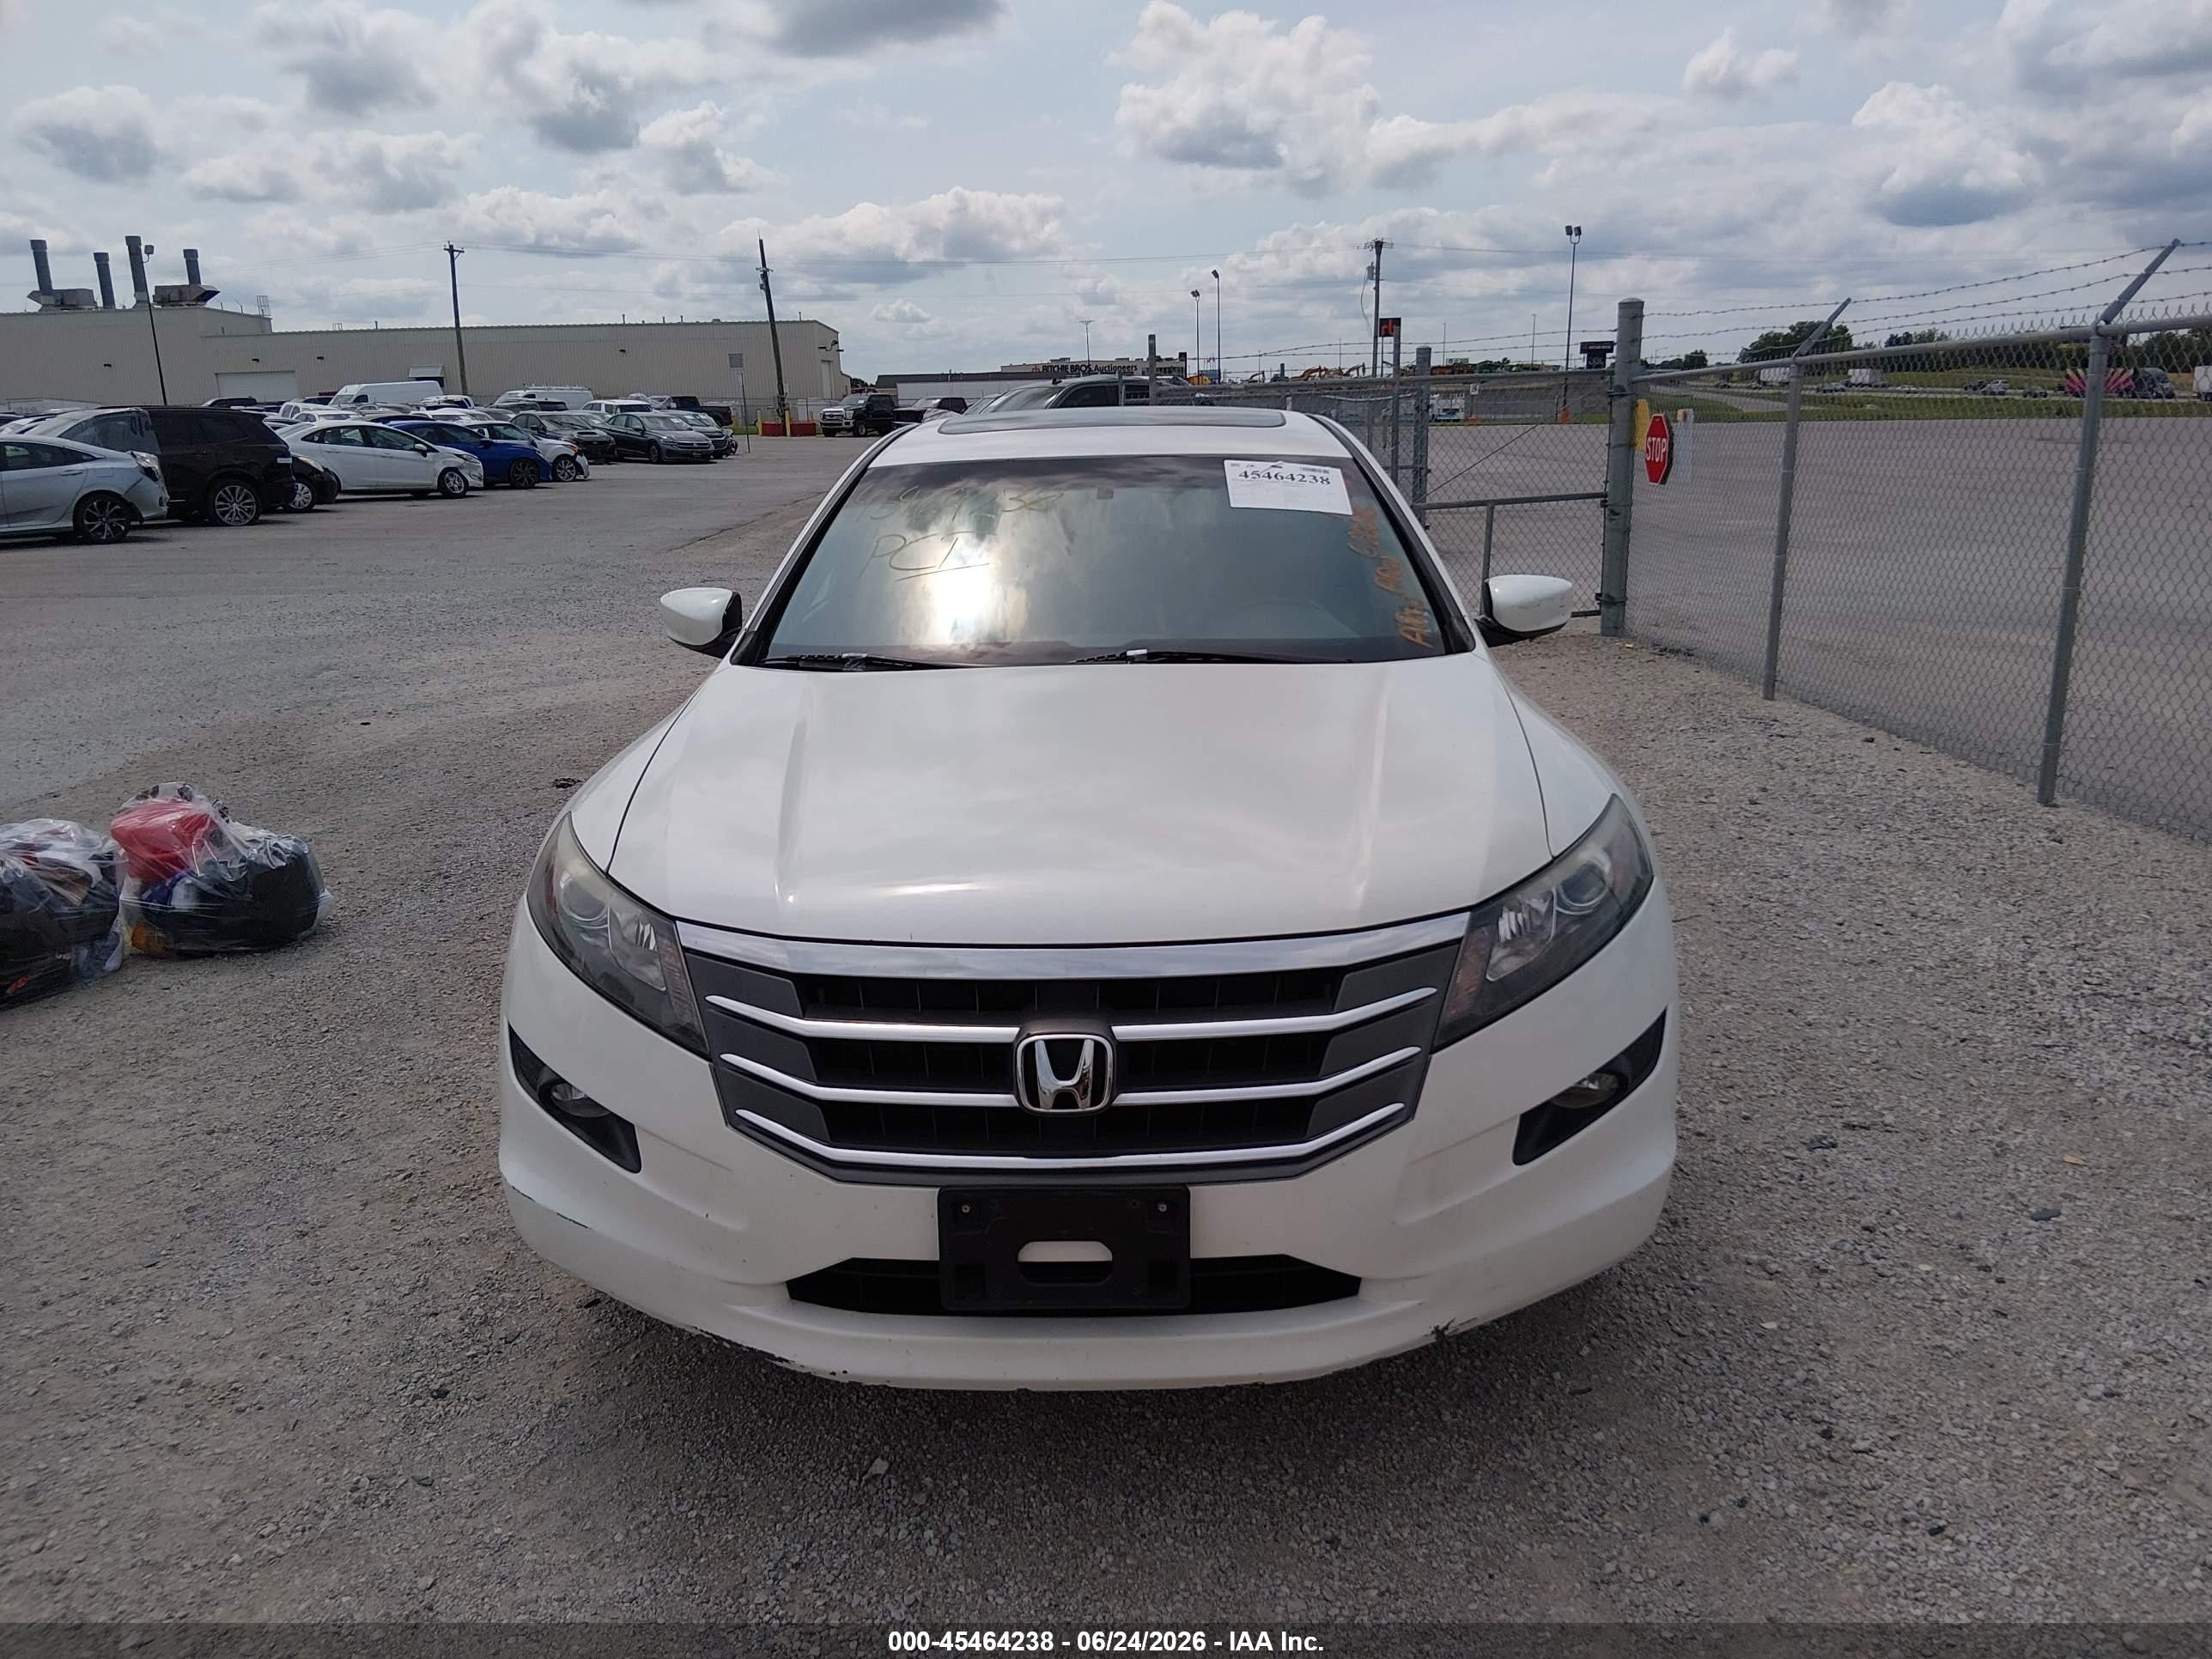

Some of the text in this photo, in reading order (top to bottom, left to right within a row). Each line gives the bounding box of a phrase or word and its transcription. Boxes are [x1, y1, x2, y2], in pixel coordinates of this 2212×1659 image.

[1042, 364, 1069, 373] RITCHIE
[1094, 363, 1138, 373] Auctioneers
[1646, 436, 1667, 463] STOP
[1238, 470, 1331, 485] 45464238
